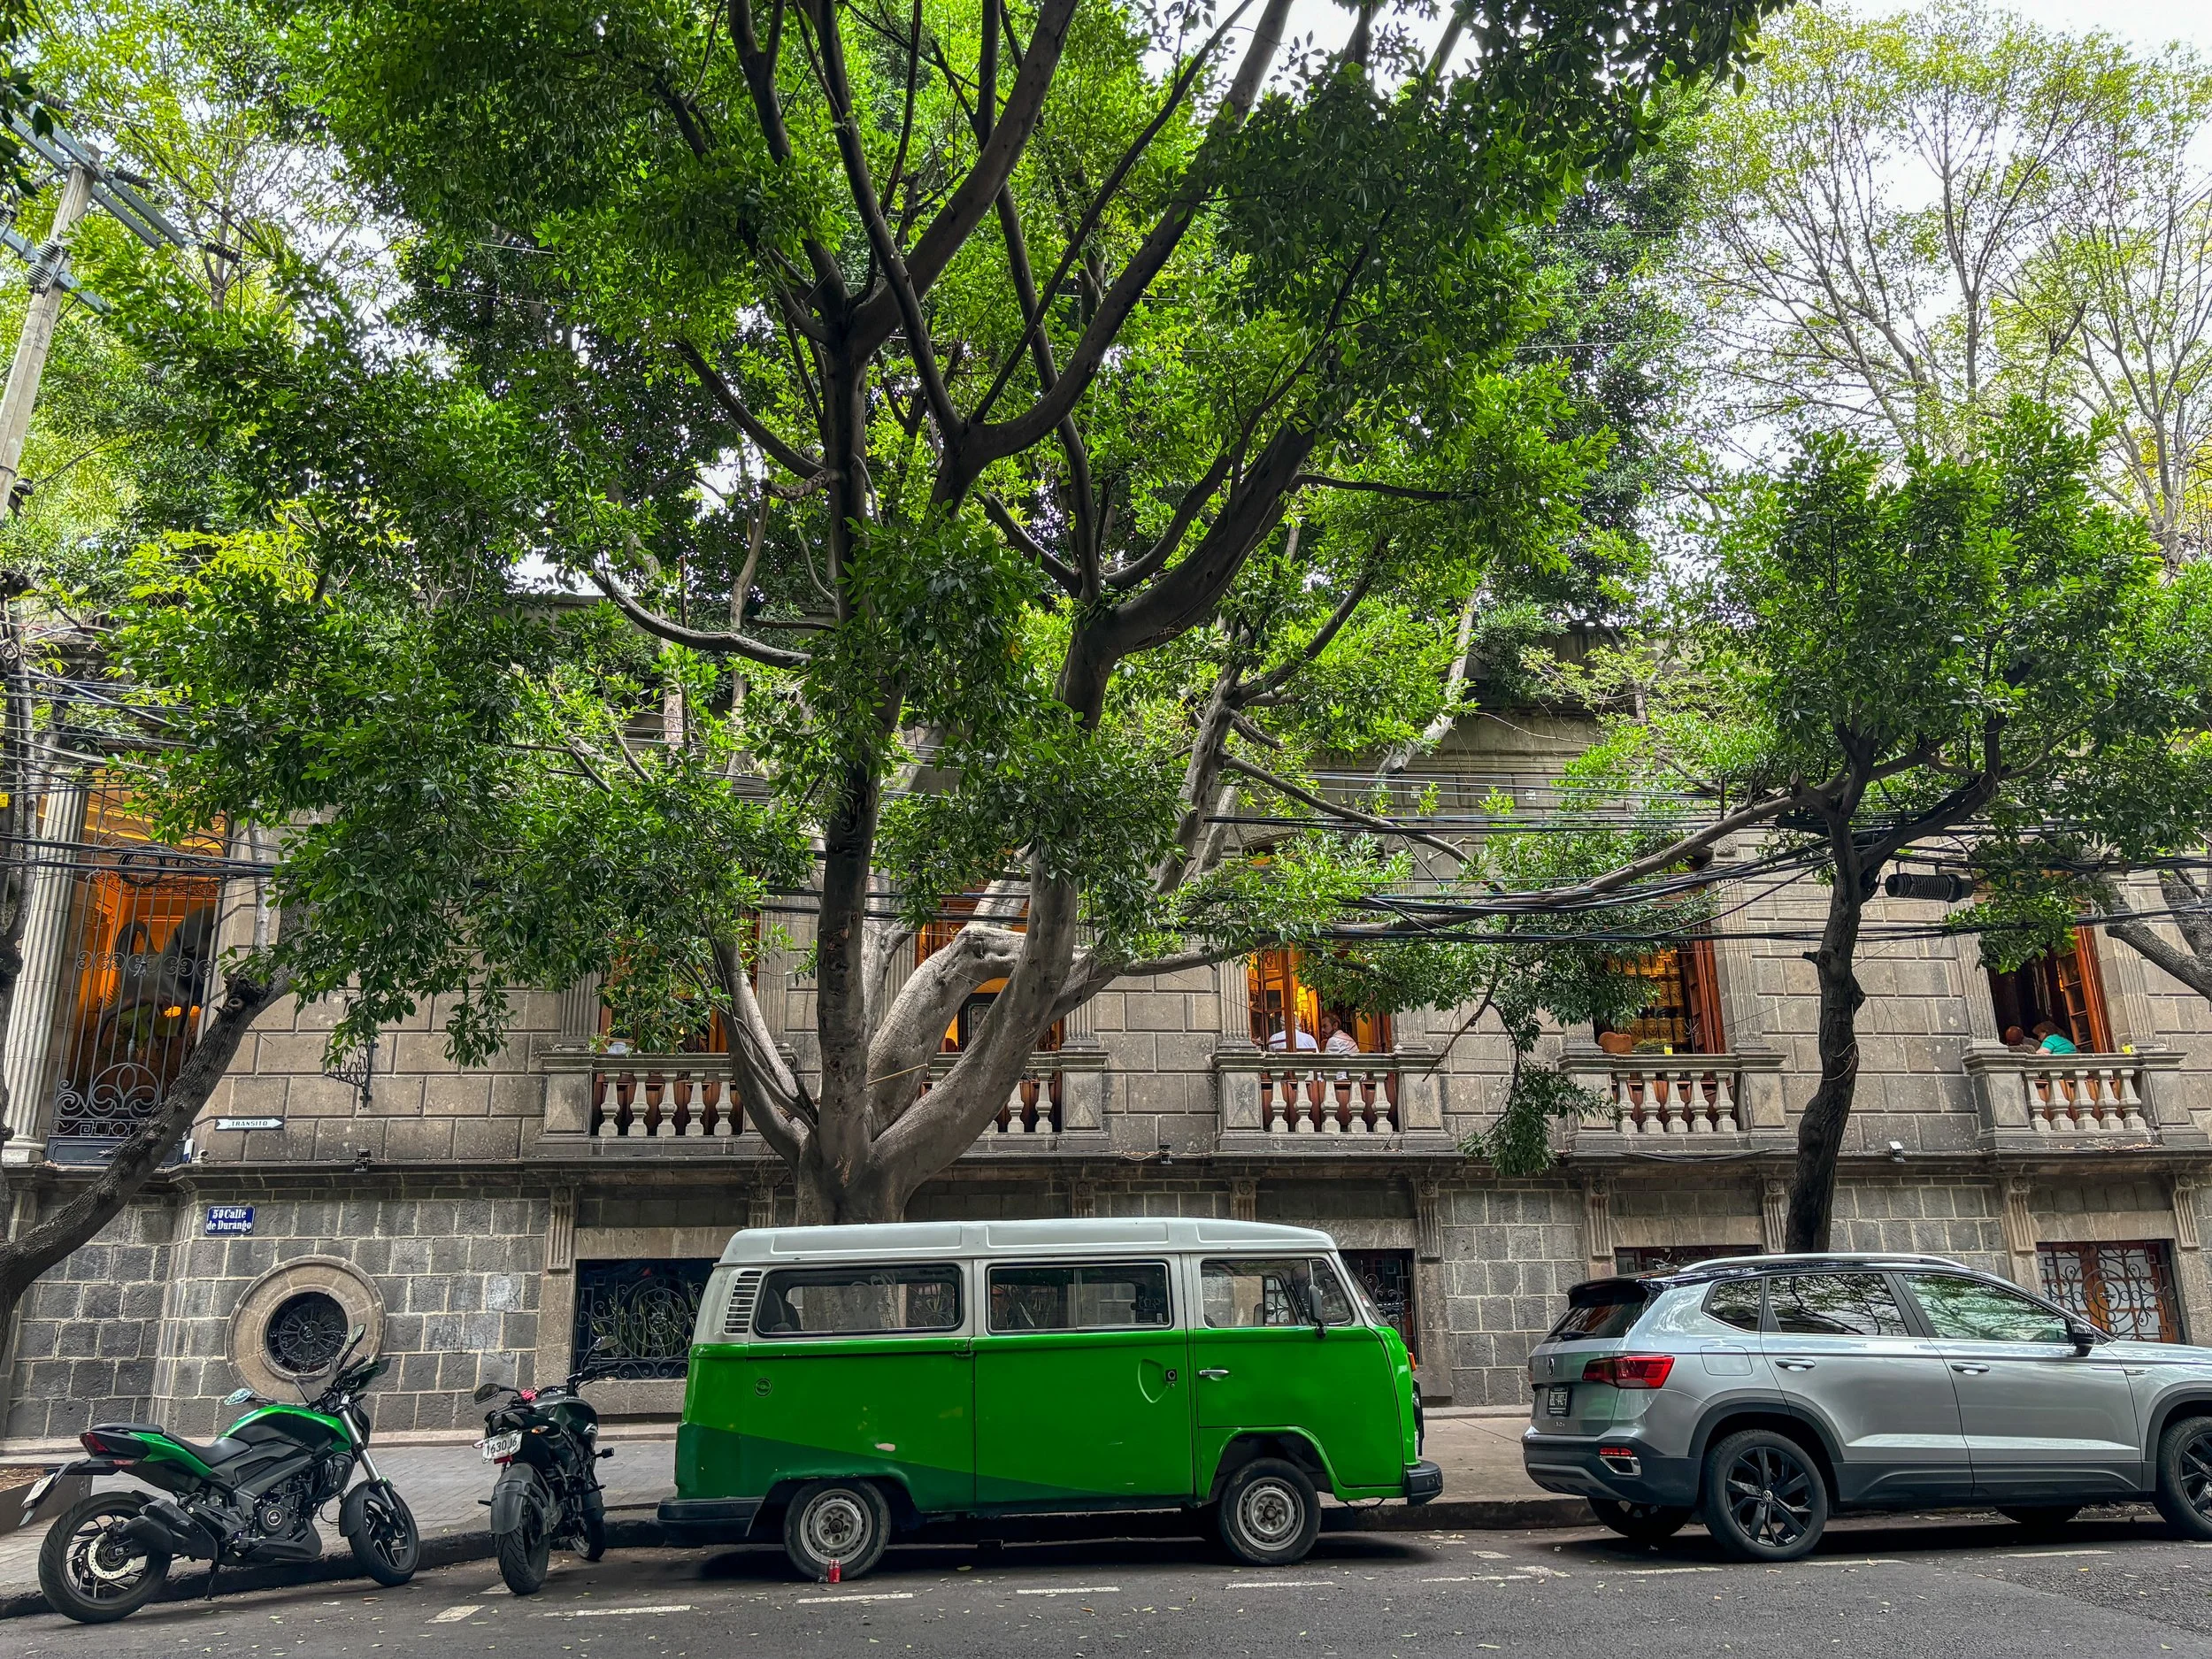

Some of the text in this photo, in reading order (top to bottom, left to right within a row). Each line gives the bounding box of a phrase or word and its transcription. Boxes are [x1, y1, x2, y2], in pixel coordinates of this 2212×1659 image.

[224, 1209, 247, 1219] Calle
[207, 1220, 252, 1233] de Durango
